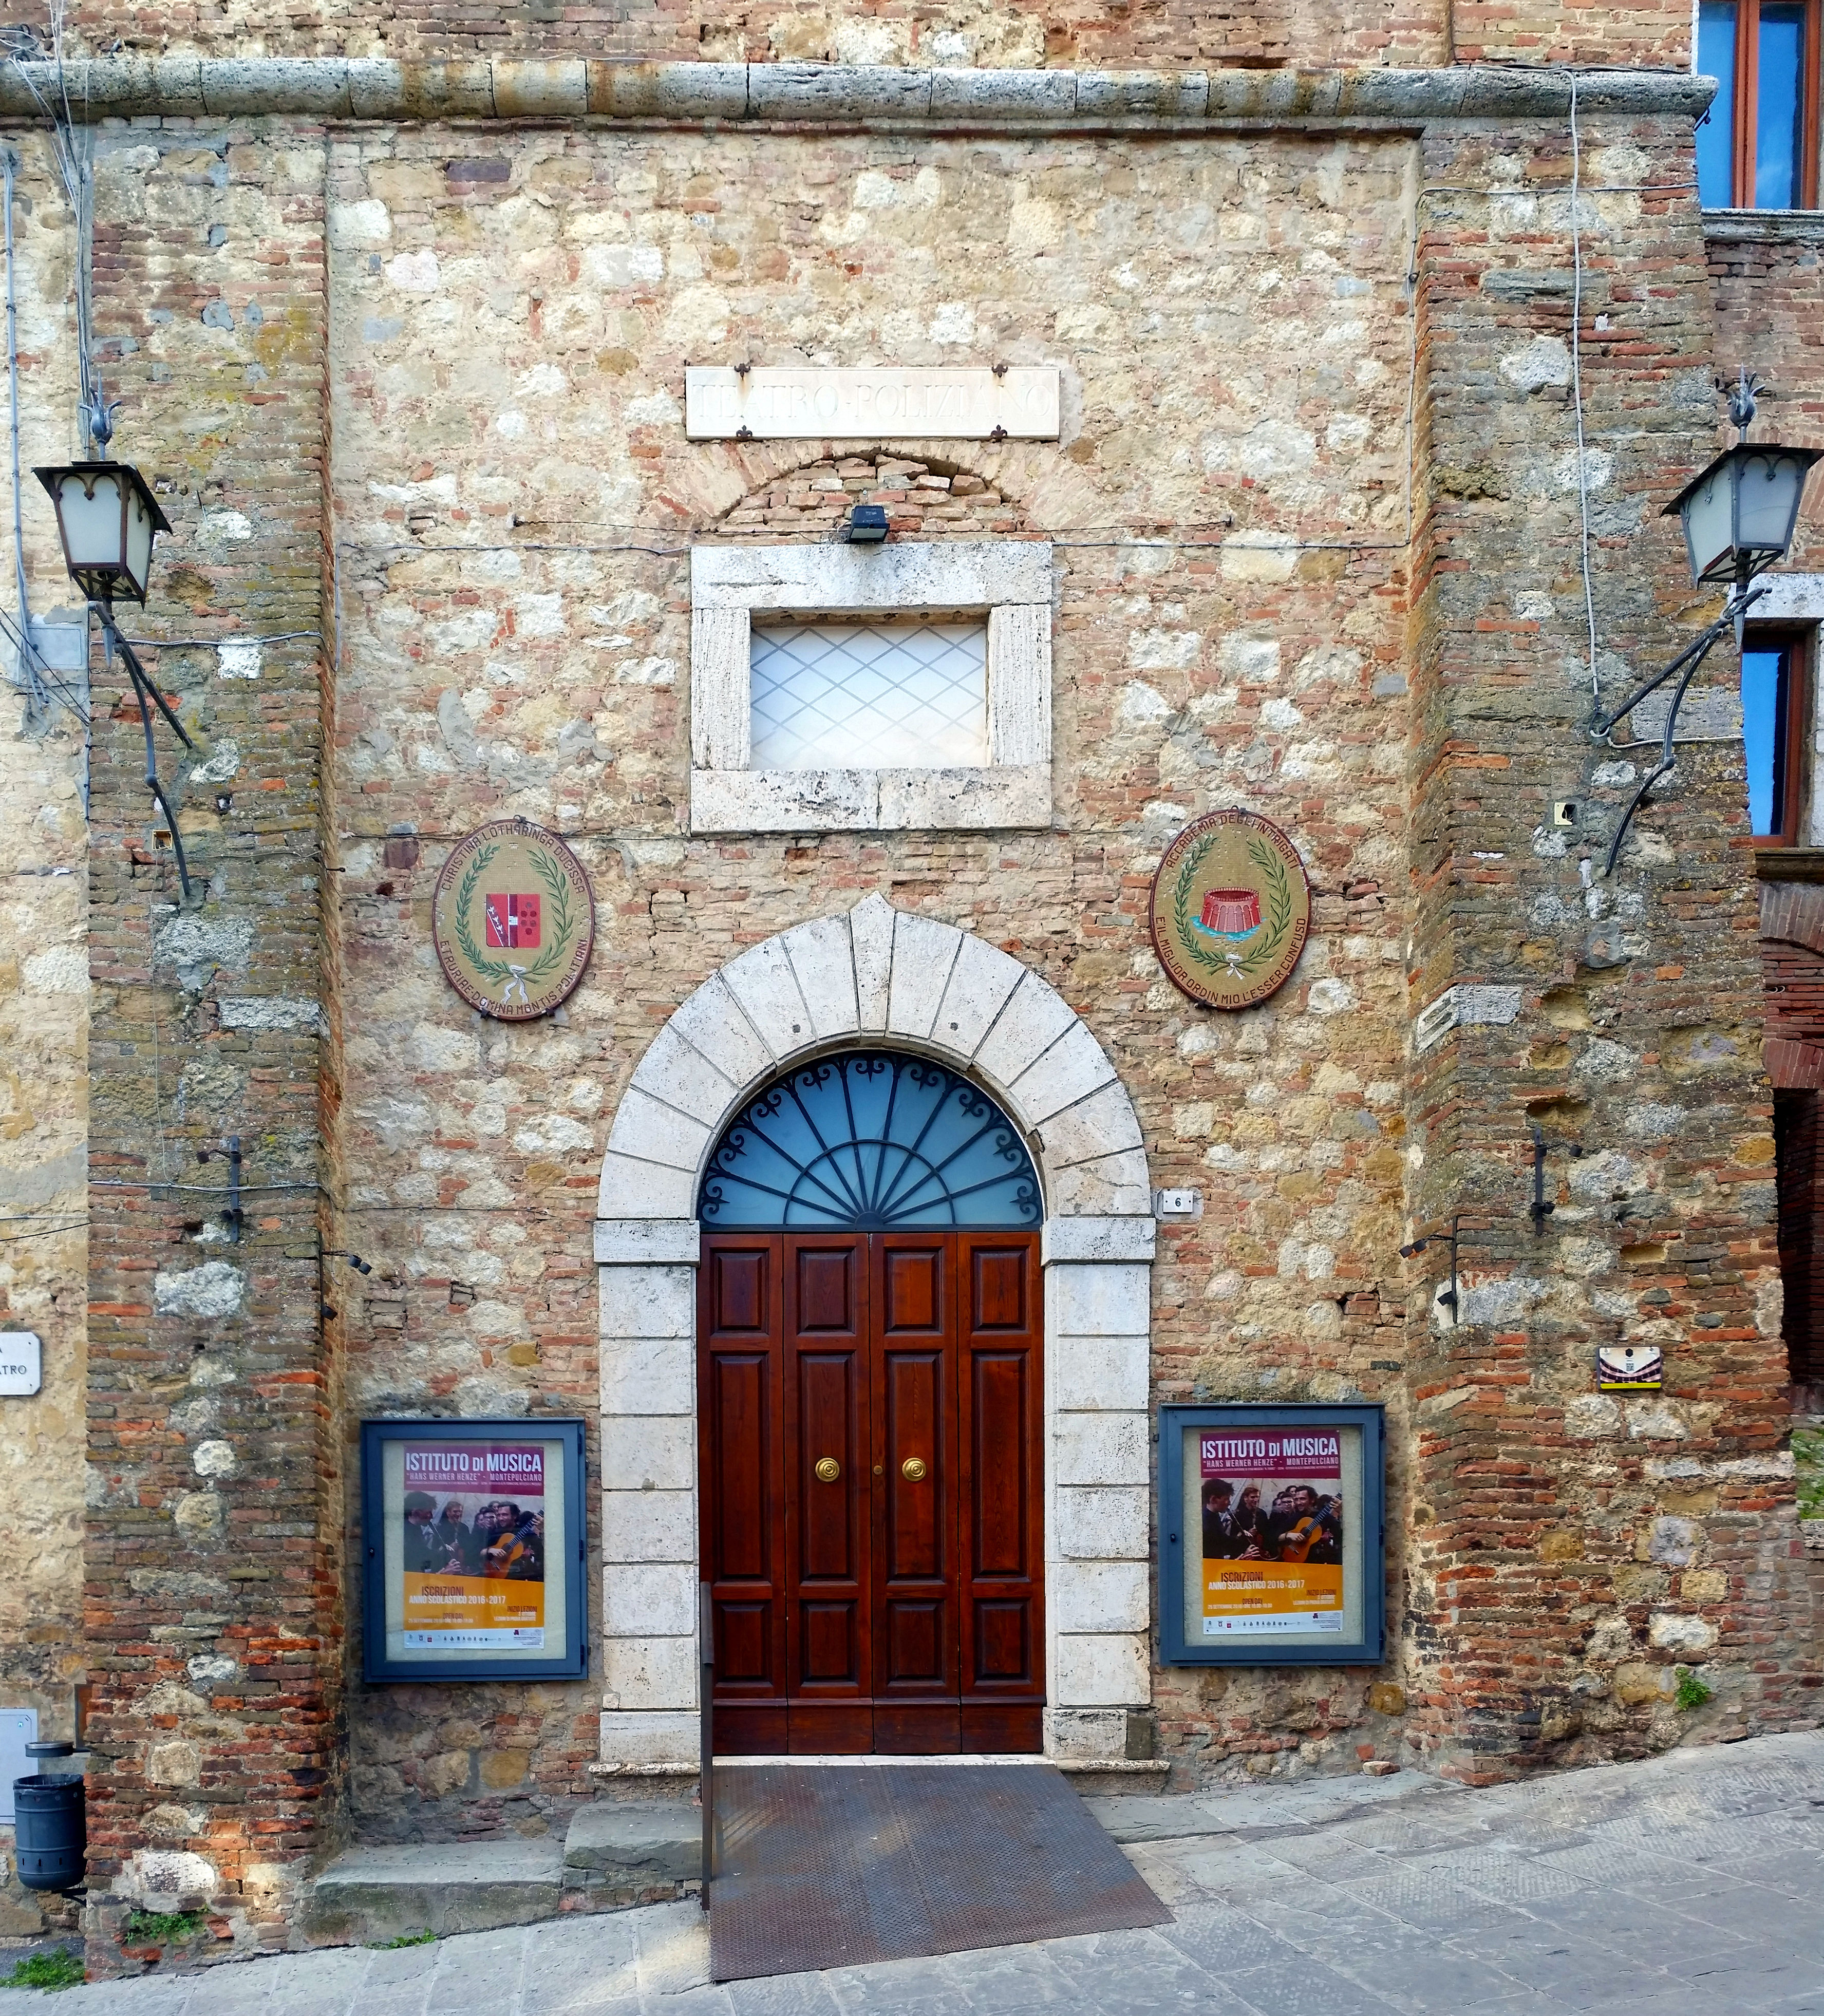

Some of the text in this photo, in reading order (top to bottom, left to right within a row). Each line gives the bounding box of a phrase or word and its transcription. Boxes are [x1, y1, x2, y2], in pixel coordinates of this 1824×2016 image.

[692, 384, 1053, 419] TEATRO POLIZIANO
[1166, 818, 1216, 868] ACCADEMIA
[1256, 821, 1299, 869] INTRIGATI
[441, 824, 585, 894] CHRISTINA LOTHARINGA DUCISSA
[1159, 939, 1188, 982] MIGLIOR
[1186, 978, 1219, 1002] ORDIN
[1220, 994, 1240, 1004] MIO
[1243, 969, 1284, 1002] L'ESSER
[1281, 918, 1306, 970] CONFUSO
[516, 991, 557, 1015] MONTIS
[1175, 1197, 1181, 1207] 6
[1202, 1437, 1339, 1459] ISTITUTO DI MUSICA
[406, 1453, 542, 1472] ISTITUTO DI MUSICA
[1225, 1459, 1252, 1467] WERNER
[1286, 1457, 1339, 1466] MONTEPULCIANO
[428, 1473, 455, 1481] WERNER
[490, 1473, 542, 1481] MONTEPULCIANO
[1221, 1571, 1263, 1582] ISCRIZIONI
[422, 1586, 464, 1596] ISCRIZIONI
[1208, 1581, 1227, 1590] ANNO
[1227, 1580, 1266, 1590] SCOLASTICO
[409, 1595, 427, 1604] ANNO
[428, 1595, 467, 1604] SCOLASTICO
